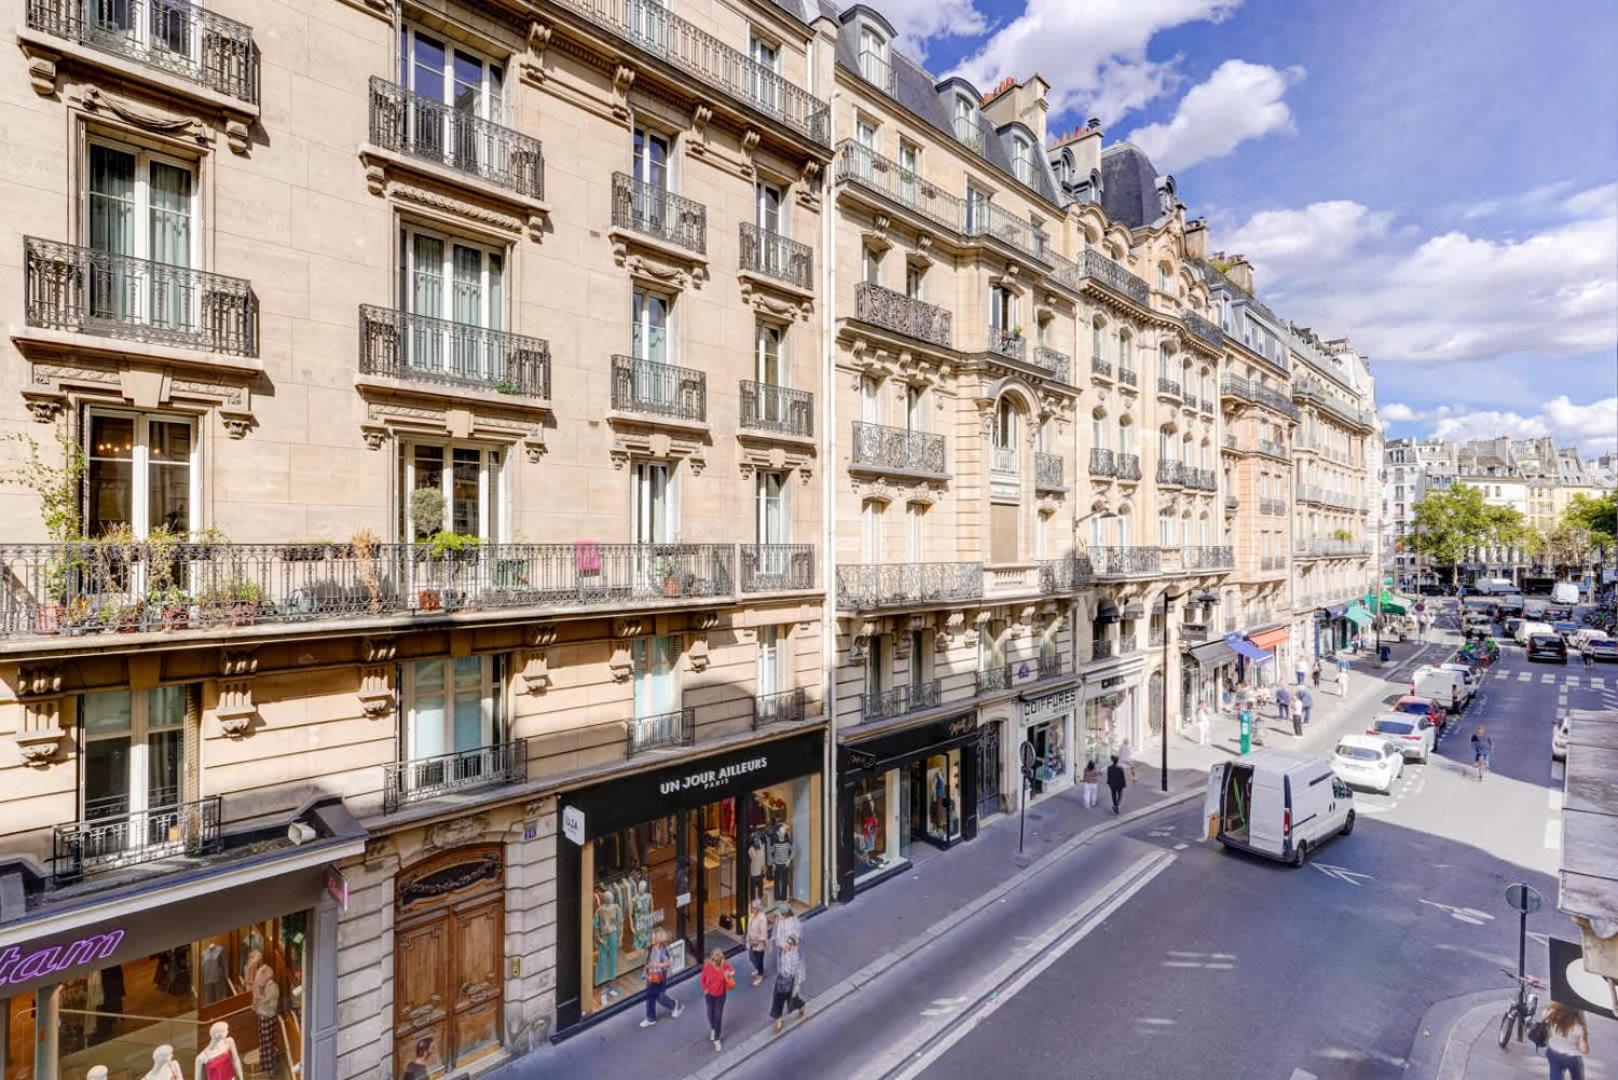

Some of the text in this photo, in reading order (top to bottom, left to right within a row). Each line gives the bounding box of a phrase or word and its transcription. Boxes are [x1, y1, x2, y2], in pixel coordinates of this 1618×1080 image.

[1024, 689, 1076, 716] COIFFURES
[659, 757, 768, 794] UN JOUR AILLEURS
[704, 778, 729, 790] PARIS
